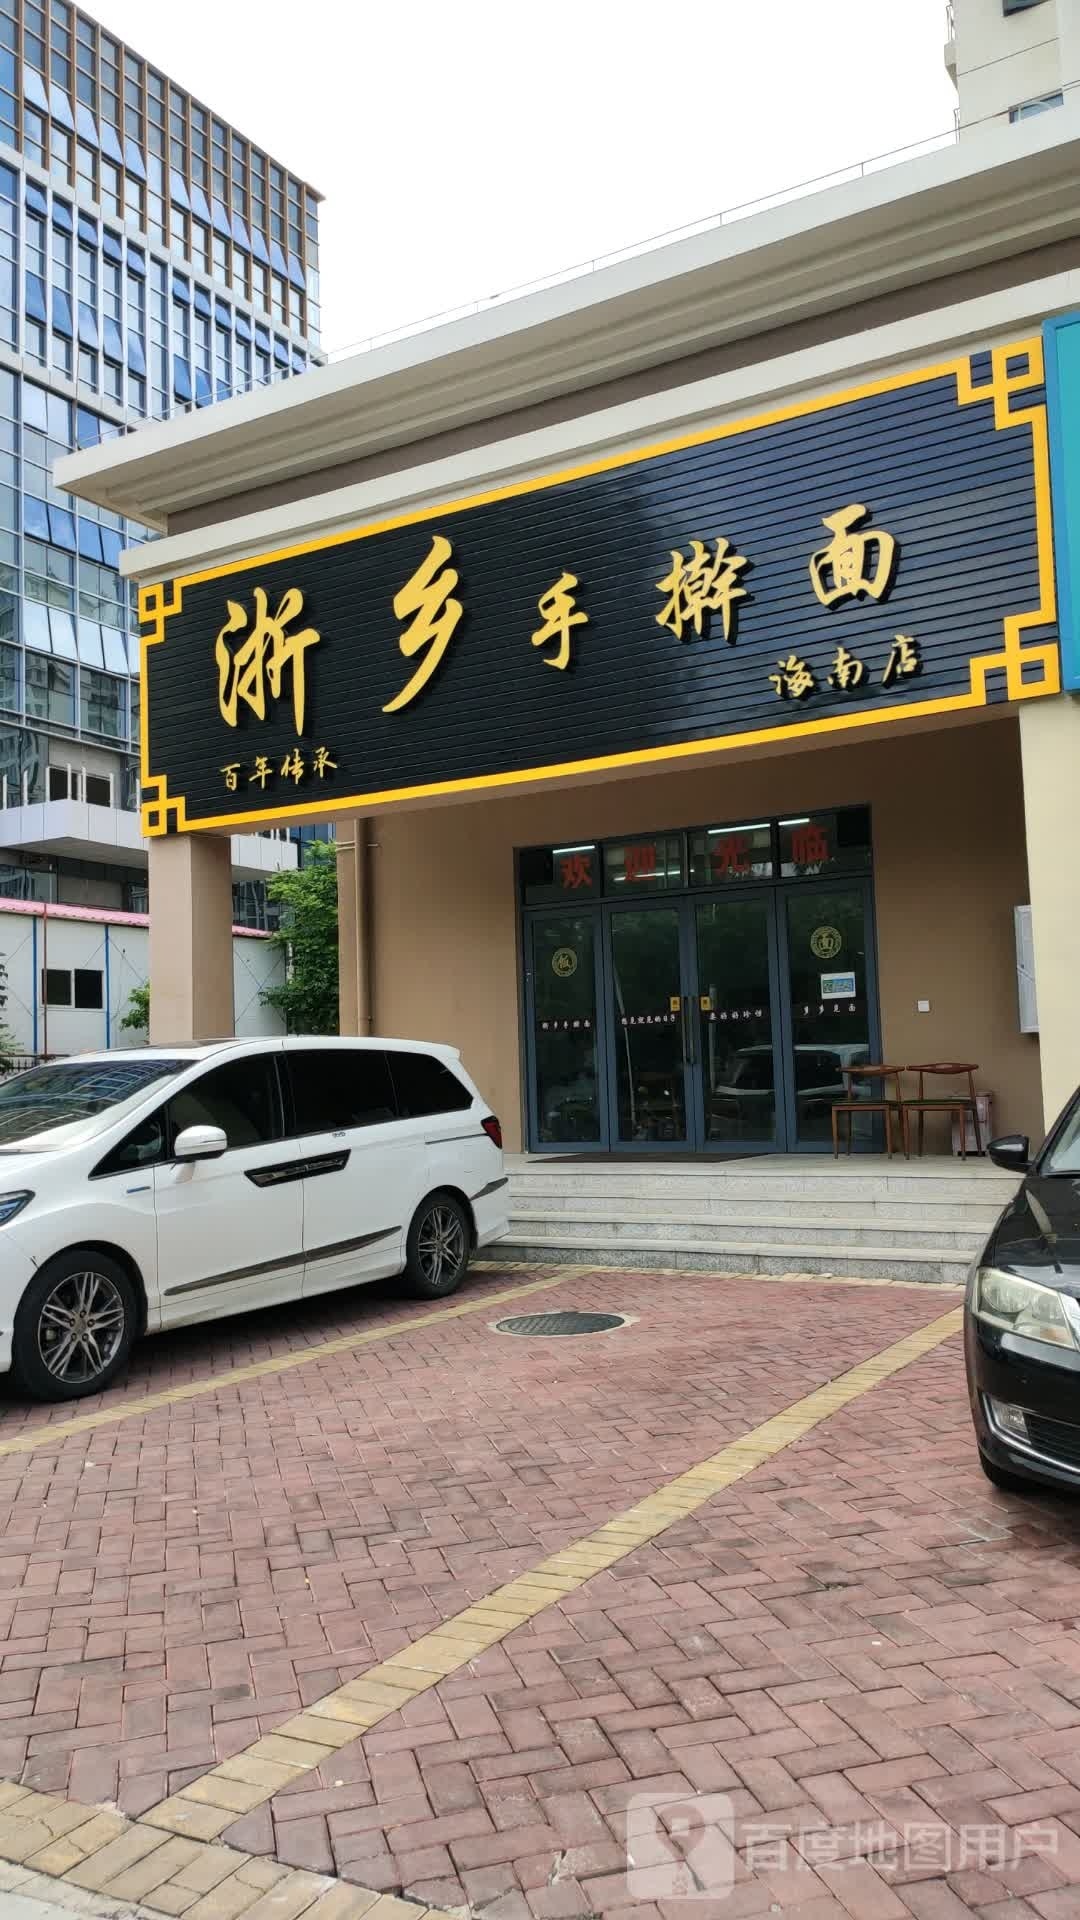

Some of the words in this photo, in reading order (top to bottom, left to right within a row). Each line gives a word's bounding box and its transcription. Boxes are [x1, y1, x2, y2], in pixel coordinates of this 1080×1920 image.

[215, 503, 899, 737] 浙乡手擀面
[769, 635, 919, 700] 海南店
[220, 746, 338, 791] 百年传承
[560, 827, 828, 887] 欢迎光临
